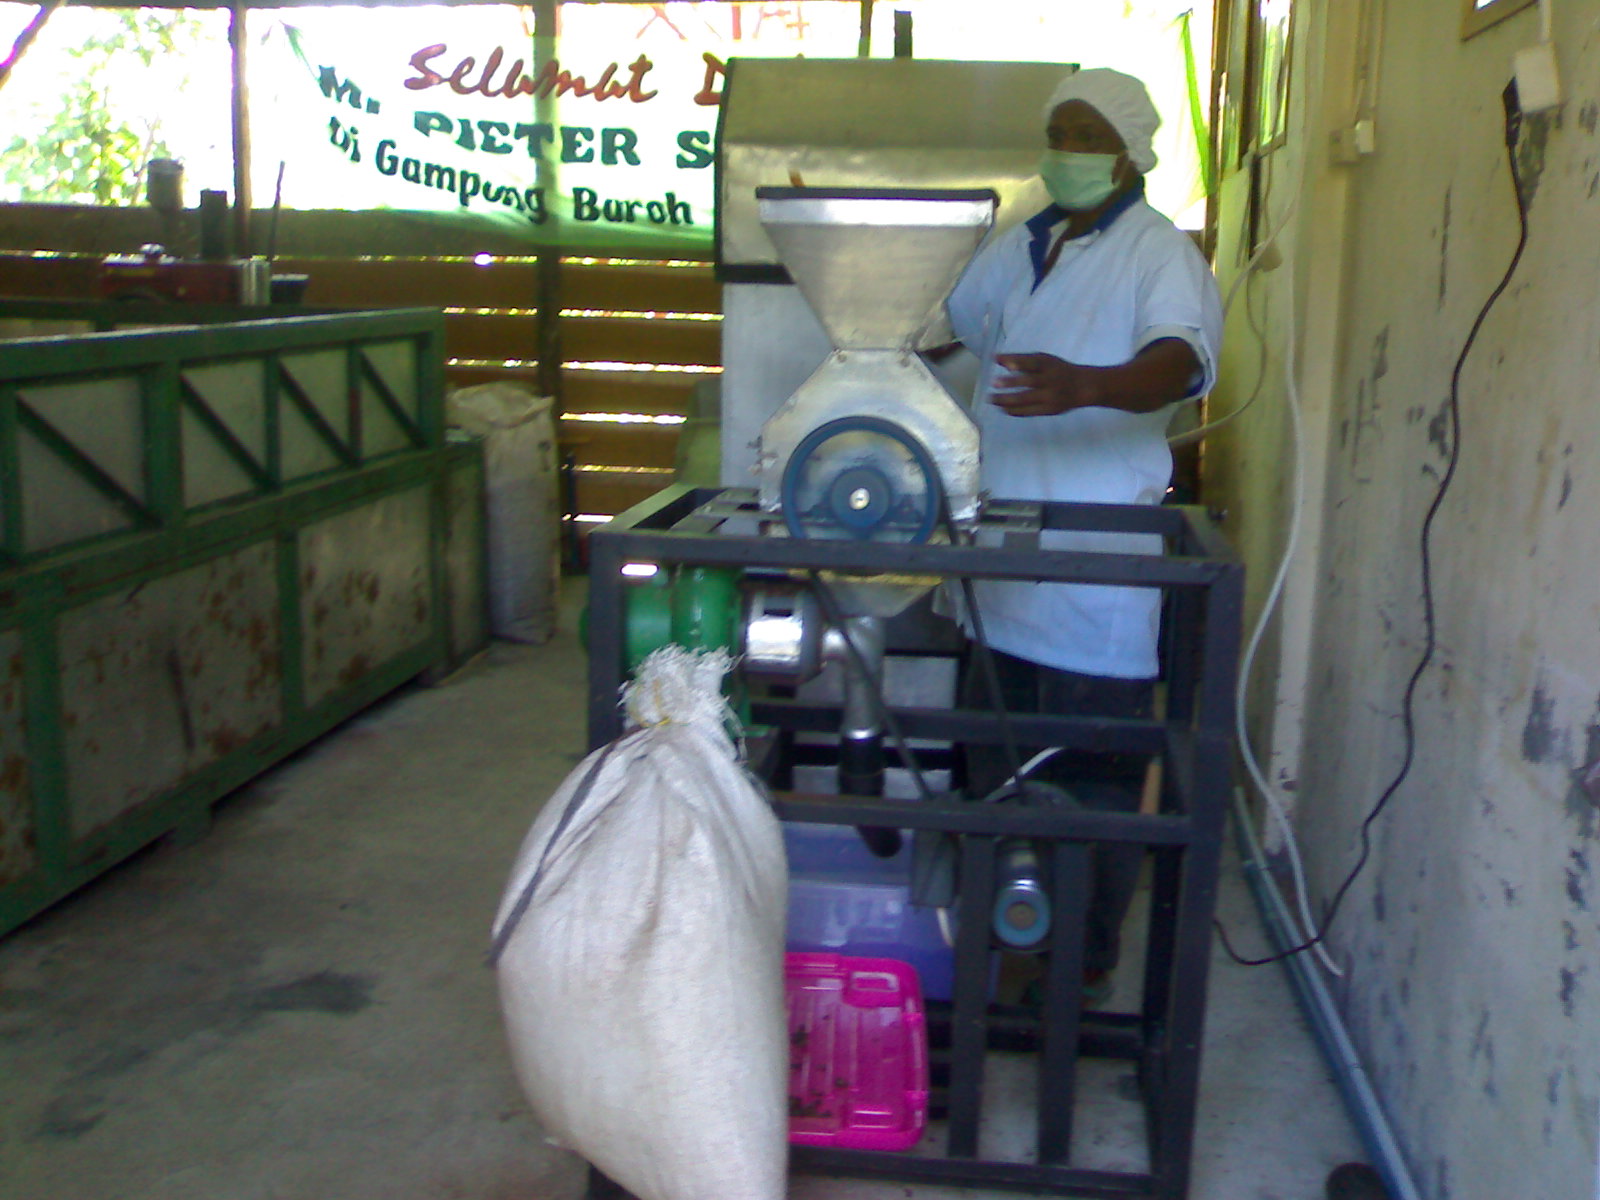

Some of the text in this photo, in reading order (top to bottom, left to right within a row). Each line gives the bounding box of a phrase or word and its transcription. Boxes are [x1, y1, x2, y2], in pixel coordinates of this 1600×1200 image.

[404, 43, 658, 103] Selamat
[414, 110, 641, 166] PIETER
[375, 138, 548, 225] Gampung
